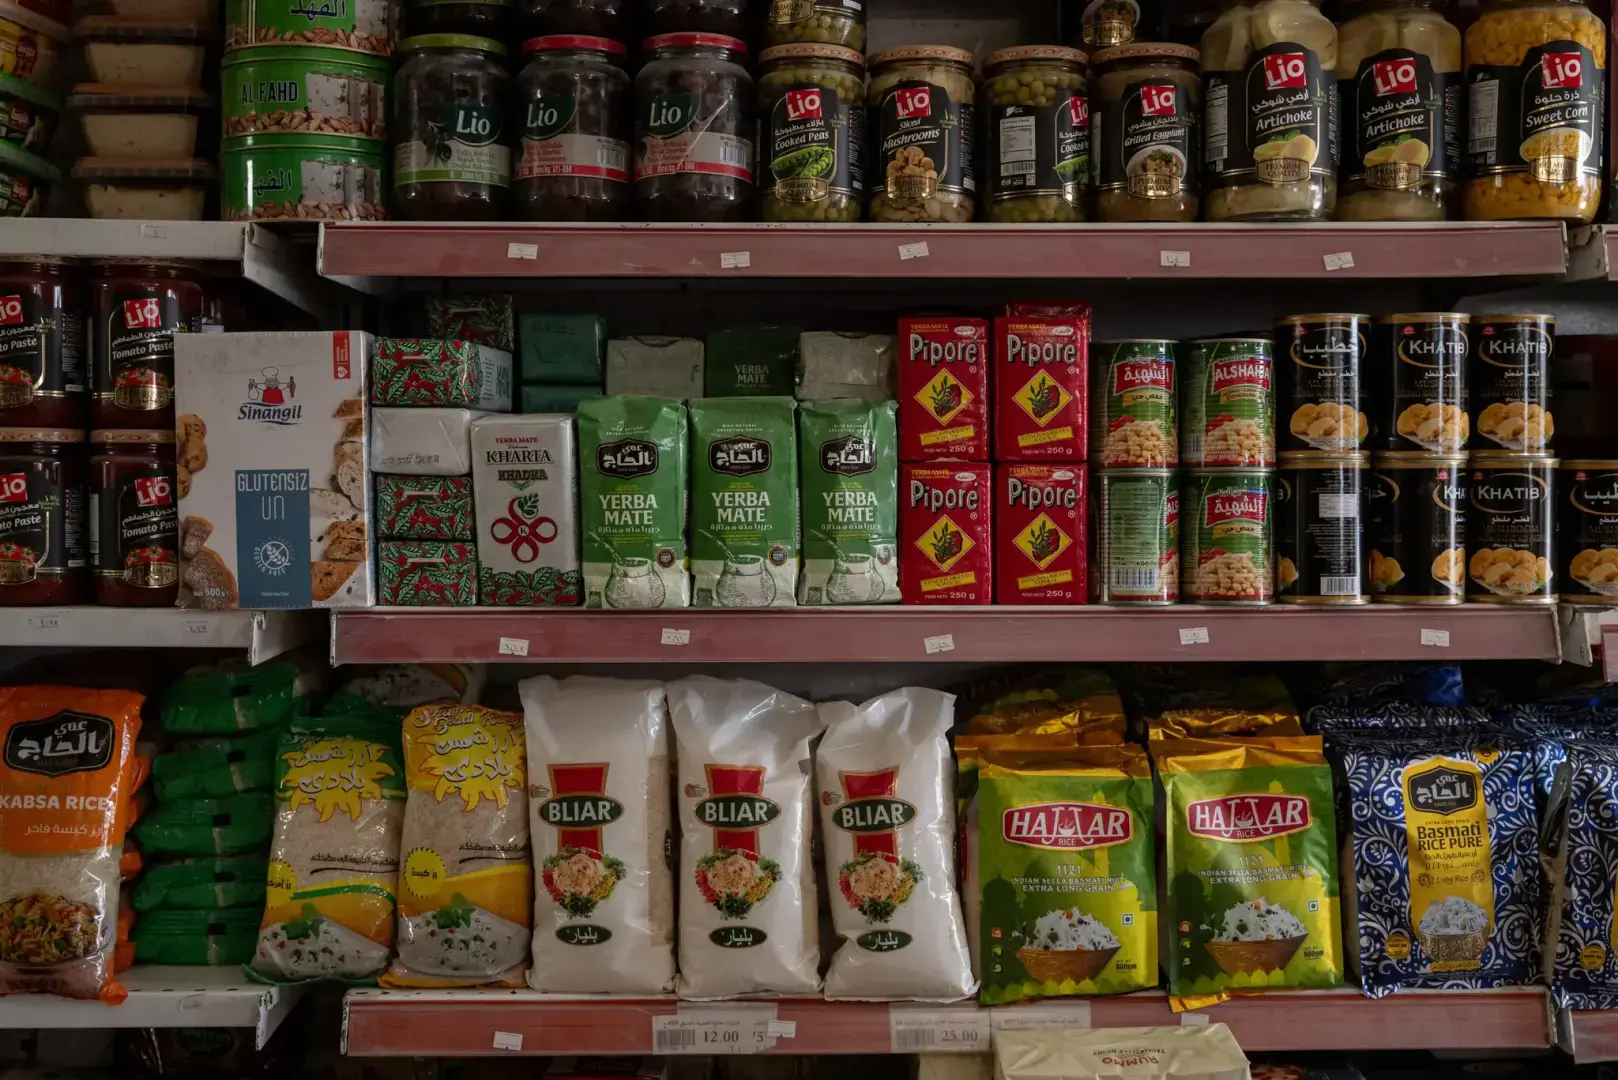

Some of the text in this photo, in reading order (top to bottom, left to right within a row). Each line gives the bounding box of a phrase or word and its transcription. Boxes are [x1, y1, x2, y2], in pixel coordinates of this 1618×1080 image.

[241, 81, 299, 104] AL FAHD
[527, 102, 559, 128] Lio
[649, 101, 682, 126] Lio
[1255, 109, 1313, 132] Artichoke
[1526, 106, 1588, 128] Sweet Corn
[456, 110, 492, 135] Lio
[1365, 113, 1425, 138] Artichoke
[775, 131, 829, 150] Cooked Peas
[882, 128, 941, 152] Mushrooms
[1125, 128, 1185, 147] Grilled Eggplant
[112, 341, 174, 360] Tomato Paste
[1409, 339, 1465, 354] KHATIB
[1490, 340, 1548, 354] KHATIB
[734, 364, 769, 374] YERBA
[737, 374, 767, 384] MATE
[237, 404, 303, 423] Sinangil
[487, 450, 553, 464] KHARTA
[711, 492, 770, 507] YERBA
[822, 492, 878, 507] YERBA
[1478, 485, 1540, 500] KHATIB
[598, 494, 658, 510] YERBA
[604, 510, 653, 525] MATE
[717, 507, 765, 522] MATE
[828, 507, 874, 522] MATE
[122, 522, 157, 538] Tomato
[969, 592, 975, 600] g
[0, 795, 108, 811] KABSA RICE
[548, 801, 612, 822] BLIAR
[705, 802, 768, 823] BLIAR
[842, 804, 905, 828] BLIAR
[1237, 829, 1255, 839] RICE
[1417, 821, 1481, 839] Basmati
[1059, 838, 1076, 846] RICE
[1418, 836, 1483, 851] RICE PURE
[1239, 856, 1265, 866] 1121
[1056, 864, 1082, 875] 1121
[1197, 869, 1226, 877] INDIAN
[1210, 873, 1298, 885] EXTRA LONG GRAIN
[570, 926, 599, 944] بليار
[724, 928, 753, 945] بليار
[869, 931, 899, 950] بليار
[704, 1030, 739, 1043] 12.00
[1102, 1055, 1160, 1068] RUMMO
